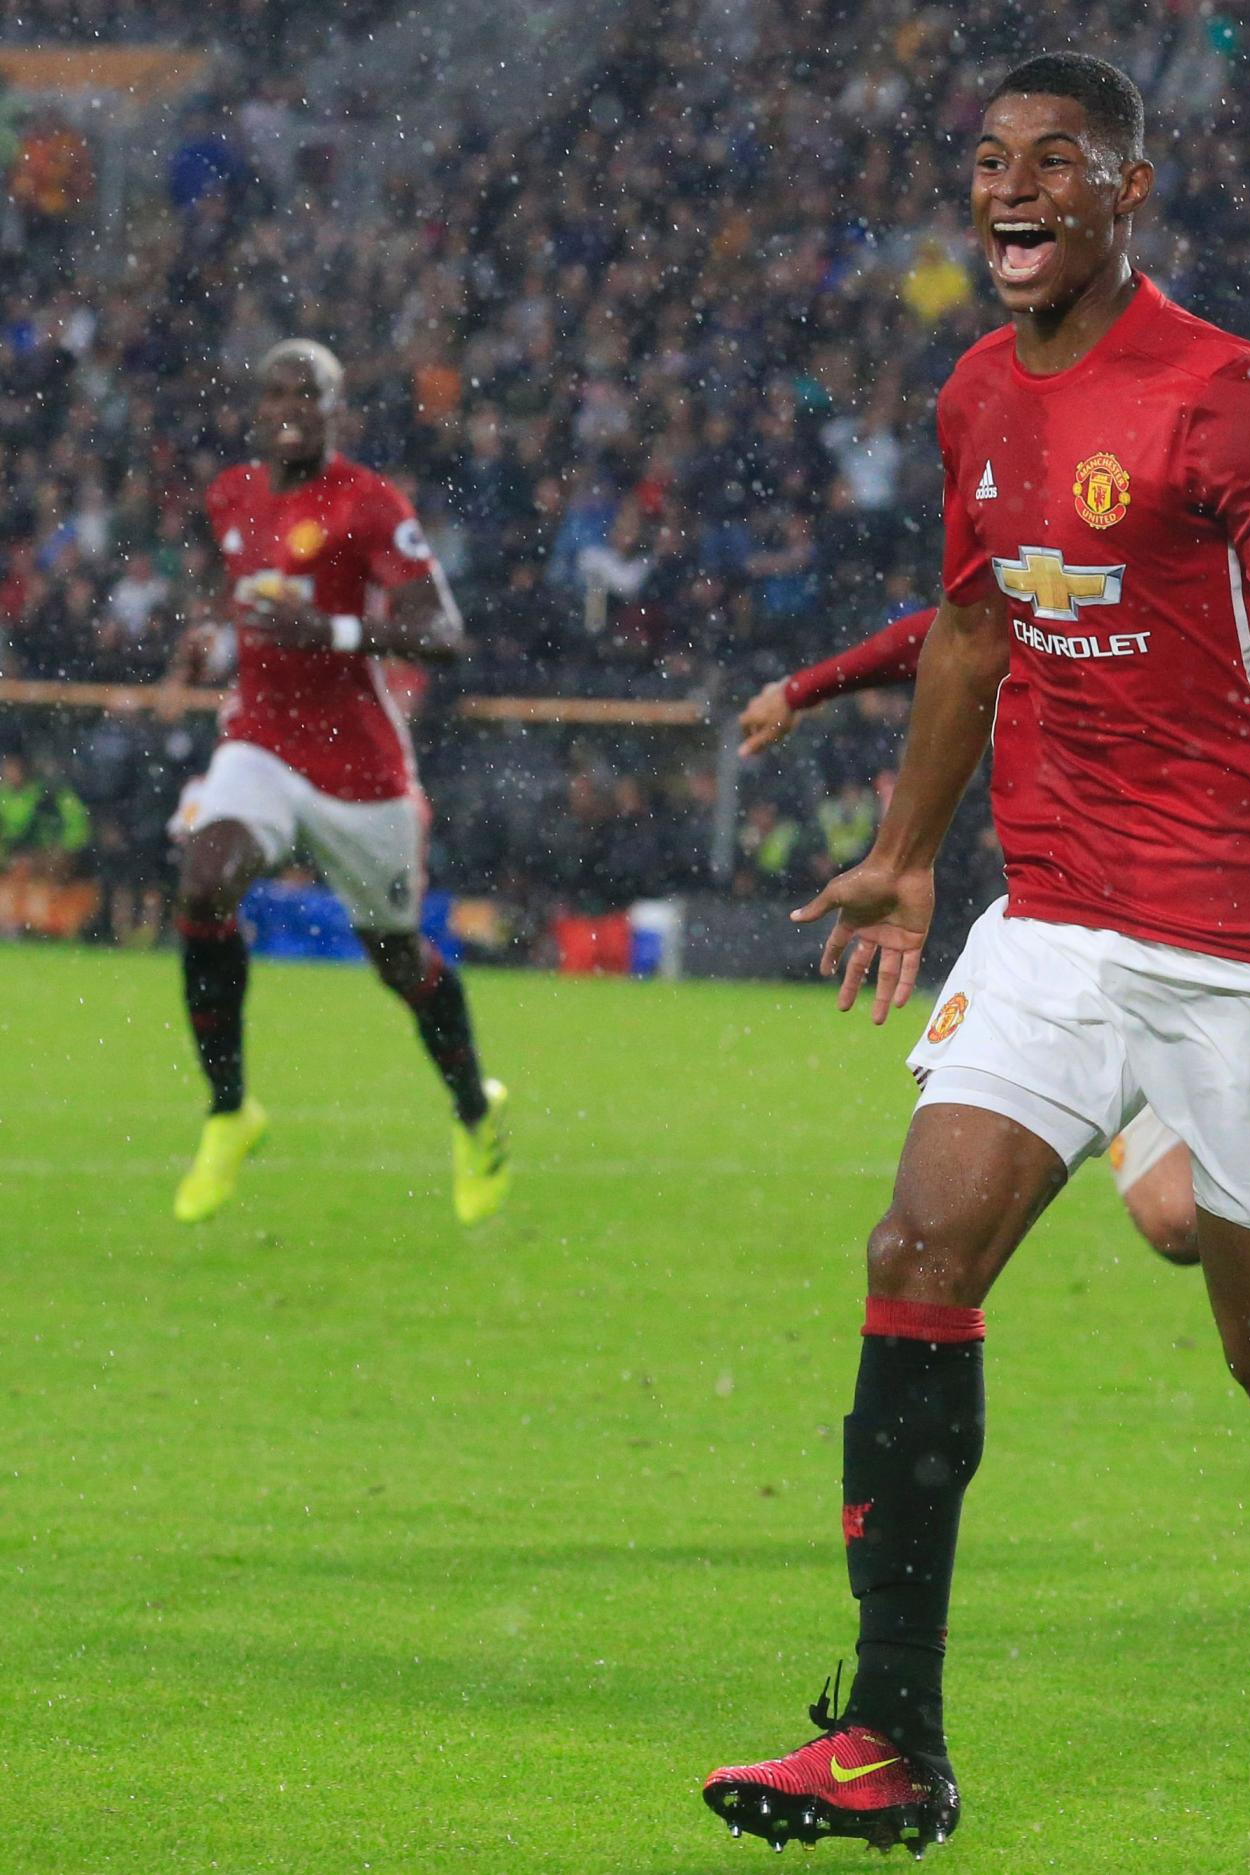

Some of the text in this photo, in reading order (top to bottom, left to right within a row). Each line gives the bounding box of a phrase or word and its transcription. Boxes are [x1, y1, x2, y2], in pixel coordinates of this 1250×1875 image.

[1080, 457, 1125, 483] MANCHESTER
[975, 484, 998, 500] adidas
[1081, 508, 1117, 524] UNITED
[1012, 618, 1151, 659] CHEVROLET
